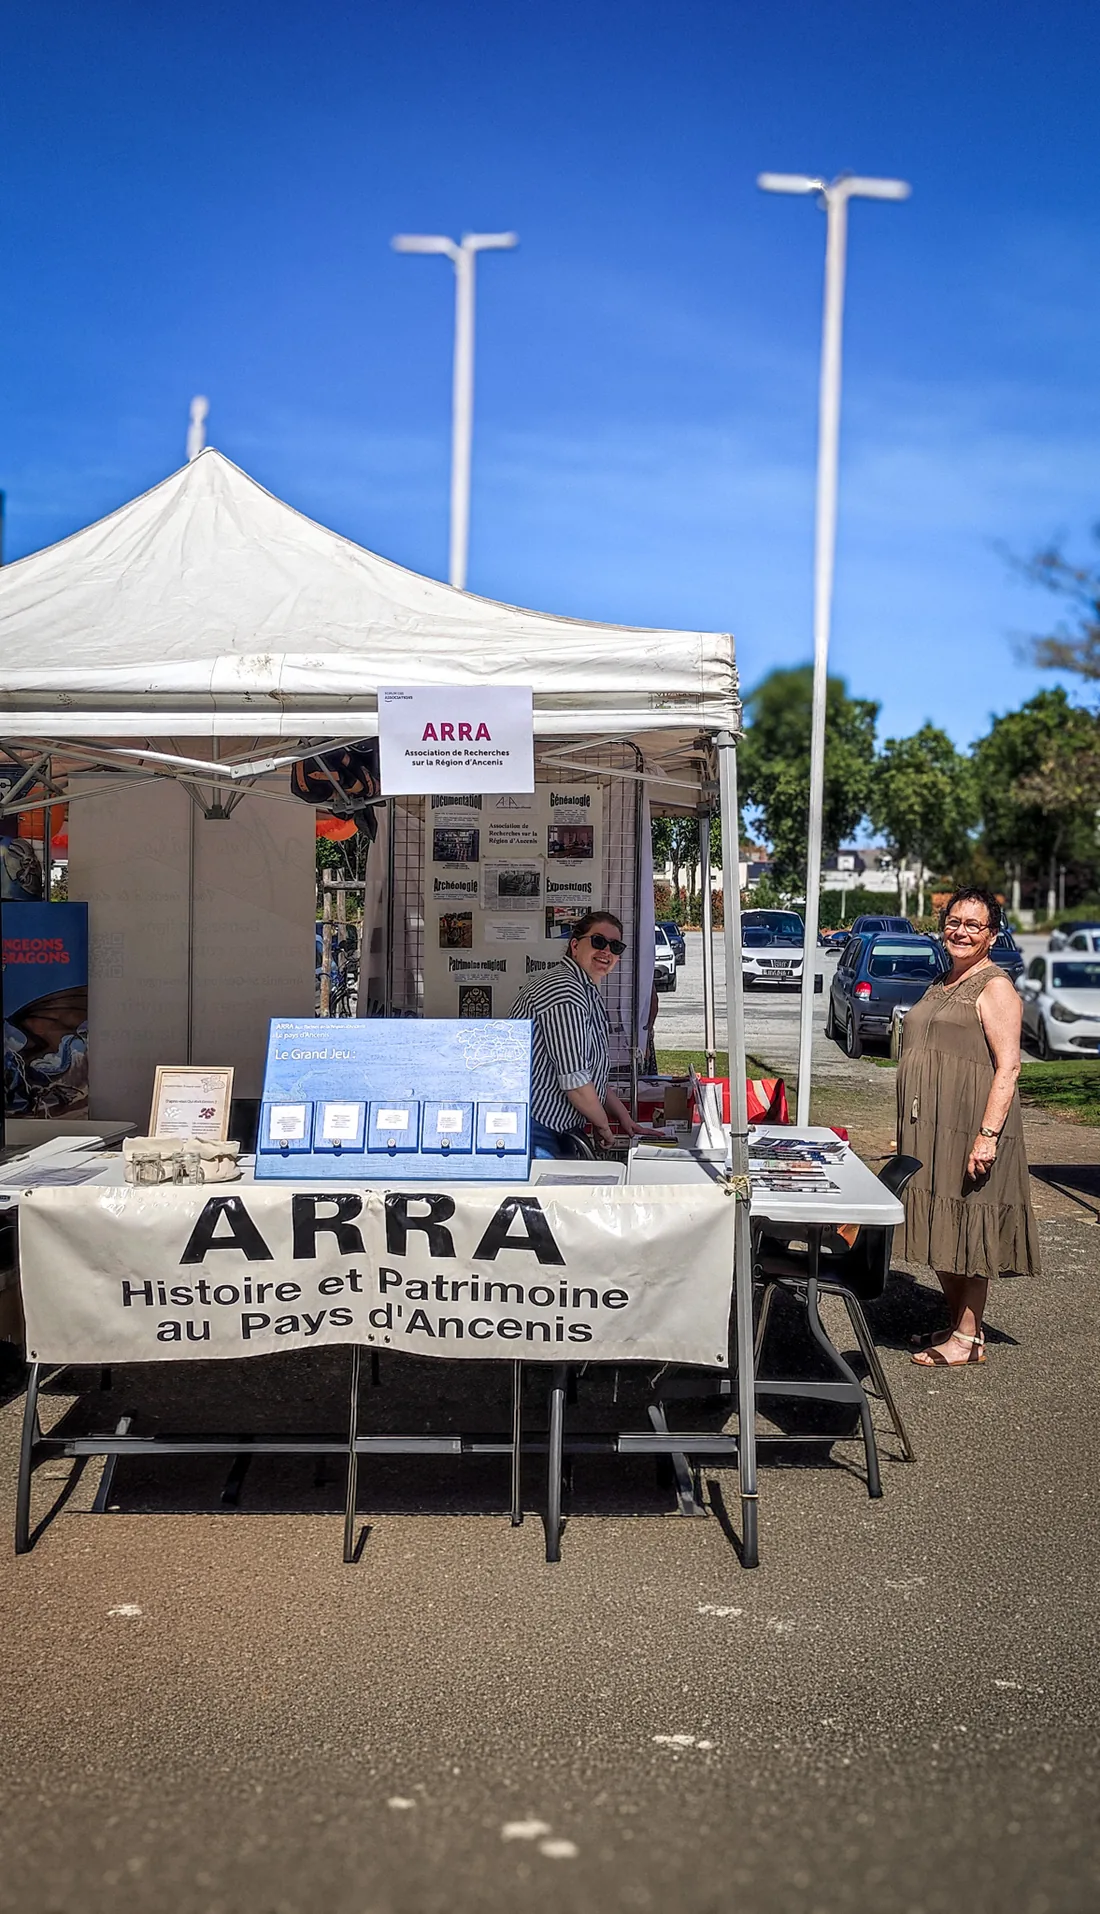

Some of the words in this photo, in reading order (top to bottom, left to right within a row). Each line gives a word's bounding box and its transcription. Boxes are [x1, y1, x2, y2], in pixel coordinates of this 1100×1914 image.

[421, 722, 492, 742] ARRA
[404, 749, 451, 757] Association
[452, 749, 462, 757] de
[463, 749, 510, 757] Recherches
[426, 758, 434, 766] la
[435, 758, 464, 768] Région
[464, 758, 504, 766] d'Ancenis
[550, 791, 591, 808] Généalogie
[488, 837, 509, 845] Région
[433, 877, 478, 893] Archéologie
[449, 956, 480, 972] Patrimoine
[480, 958, 507, 972] religieux
[525, 954, 547, 974] Revue
[275, 1049, 289, 1060] Le
[291, 1048, 328, 1060] Grand
[329, 1048, 351, 1060] Jeu
[178, 1192, 567, 1266] ARRA
[121, 1276, 302, 1307] Histoire
[318, 1268, 363, 1296] et
[379, 1267, 629, 1310] Patrimoine
[156, 1319, 210, 1342] au
[241, 1307, 354, 1340] Pays
[368, 1302, 593, 1343] d'Ancenis
